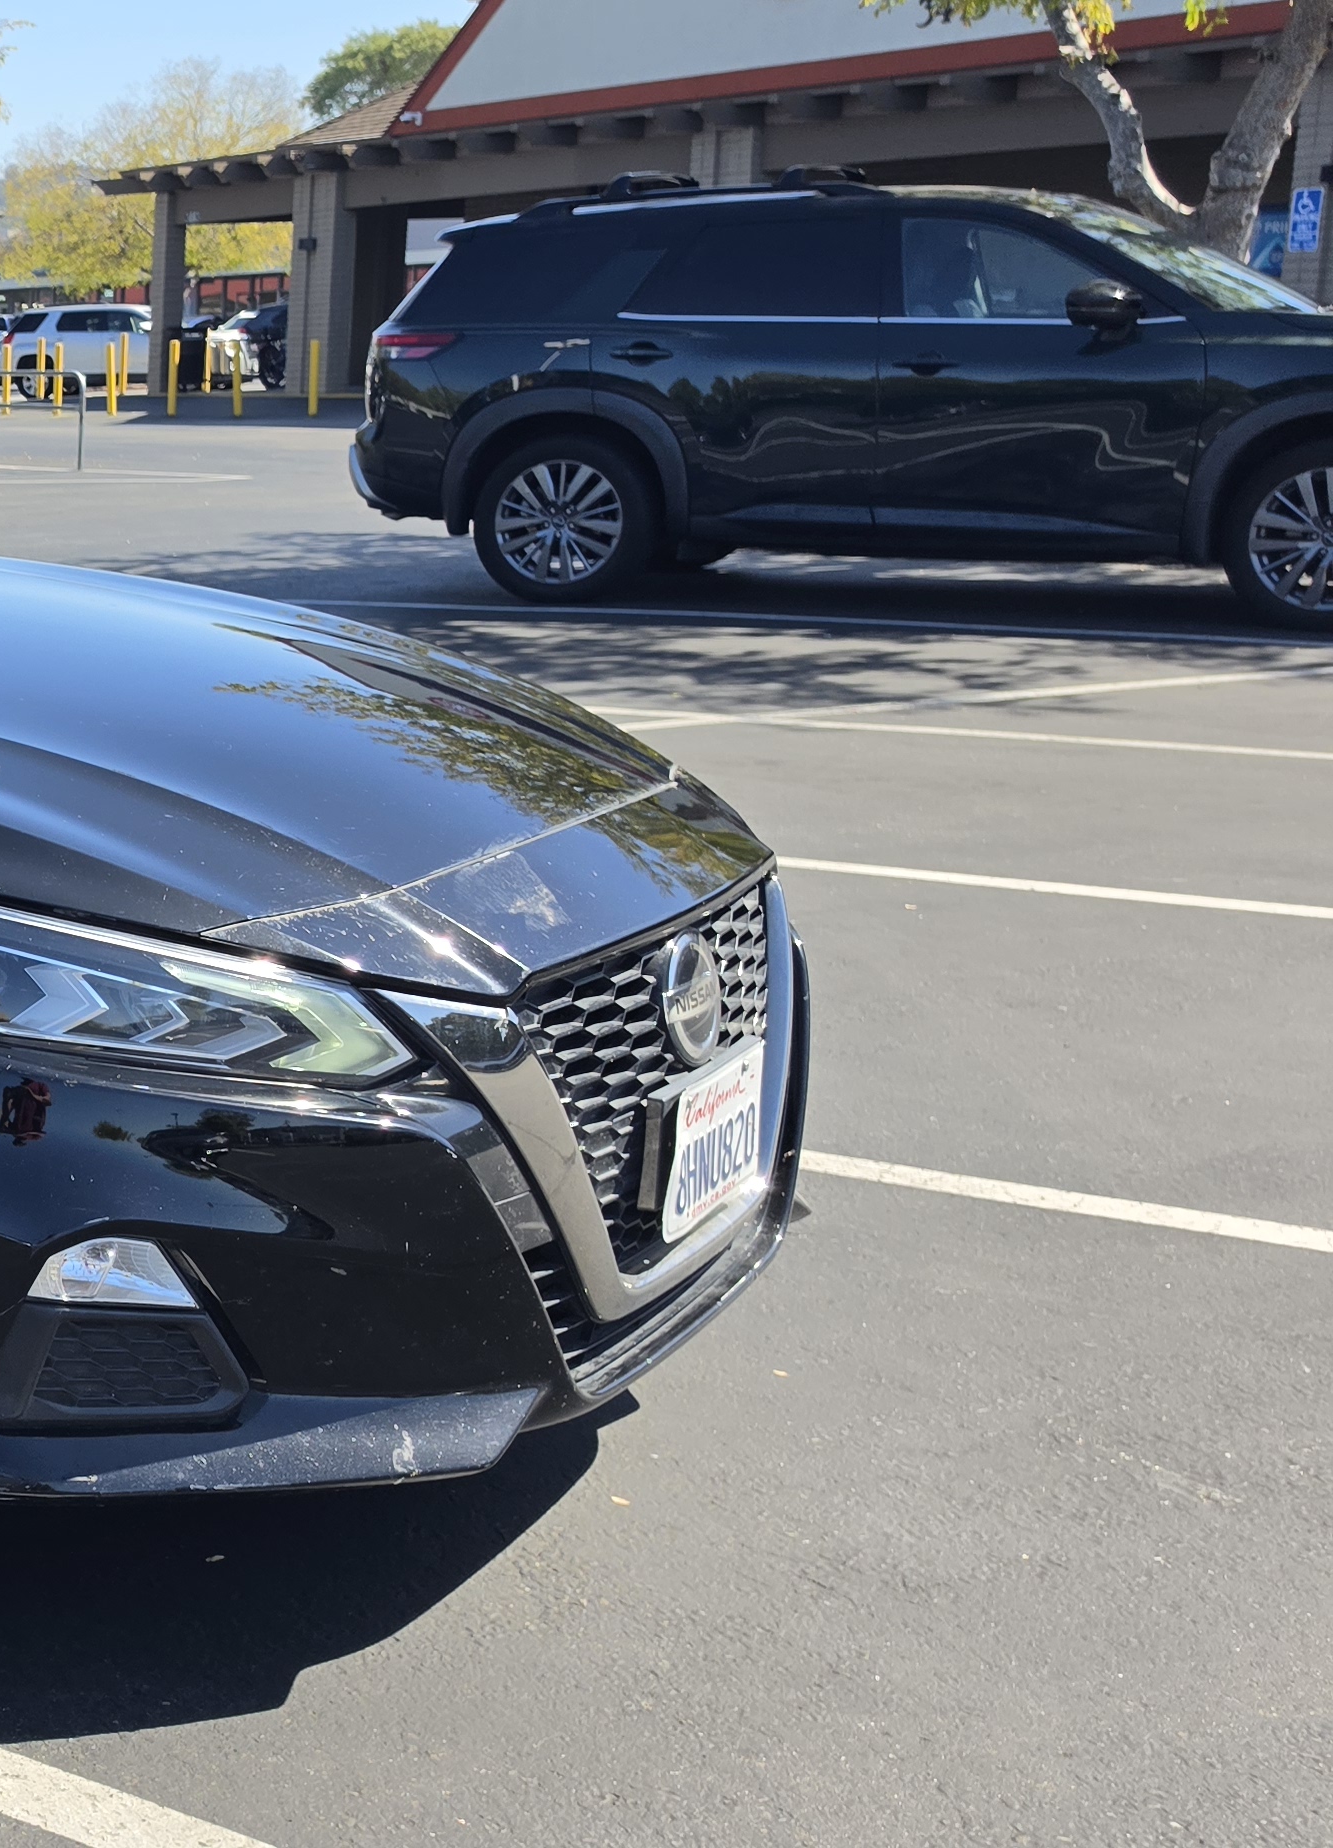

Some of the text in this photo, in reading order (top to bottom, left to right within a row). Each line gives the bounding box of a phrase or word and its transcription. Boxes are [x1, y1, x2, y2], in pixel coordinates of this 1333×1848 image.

[675, 984, 718, 1016] NISSAN
[685, 1078, 746, 1128] California
[675, 1101, 755, 1216] 8HNU820
